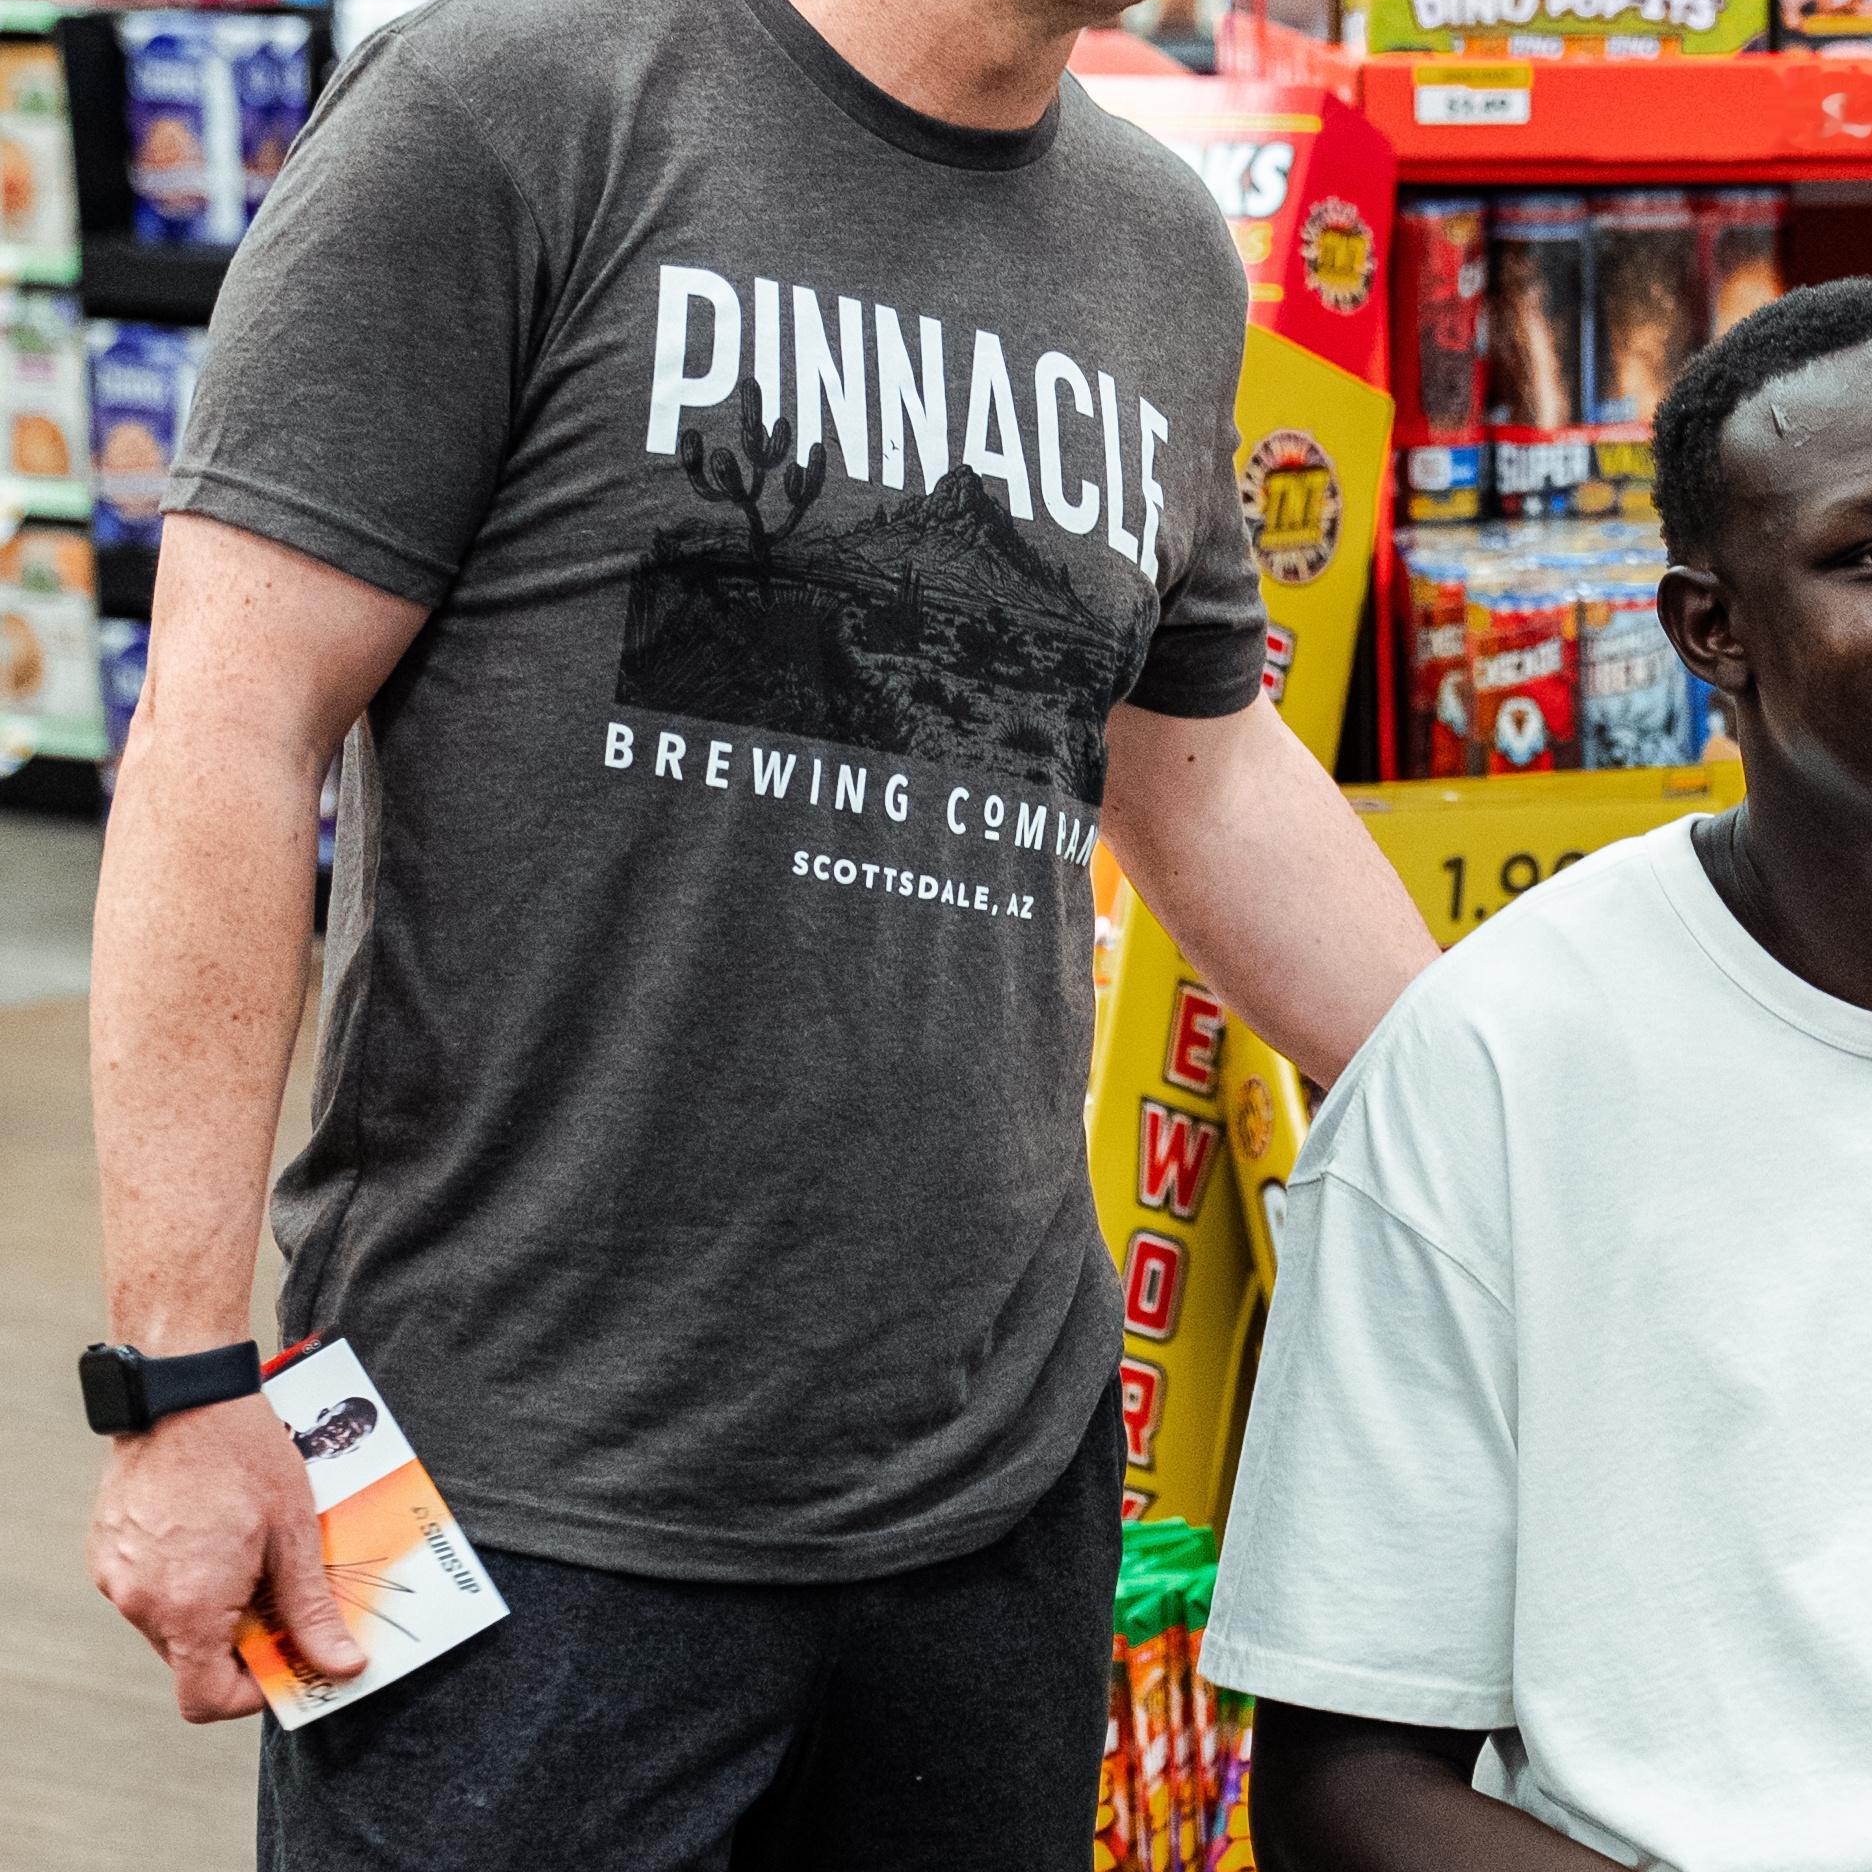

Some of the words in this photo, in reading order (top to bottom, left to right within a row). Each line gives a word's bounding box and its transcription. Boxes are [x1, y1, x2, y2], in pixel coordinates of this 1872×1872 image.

[646, 264, 1169, 580] PINNACLE
[604, 722, 910, 823] BREWING
[792, 850, 1000, 918] SCOTTSDALE,
[1006, 892, 1035, 920] AZ
